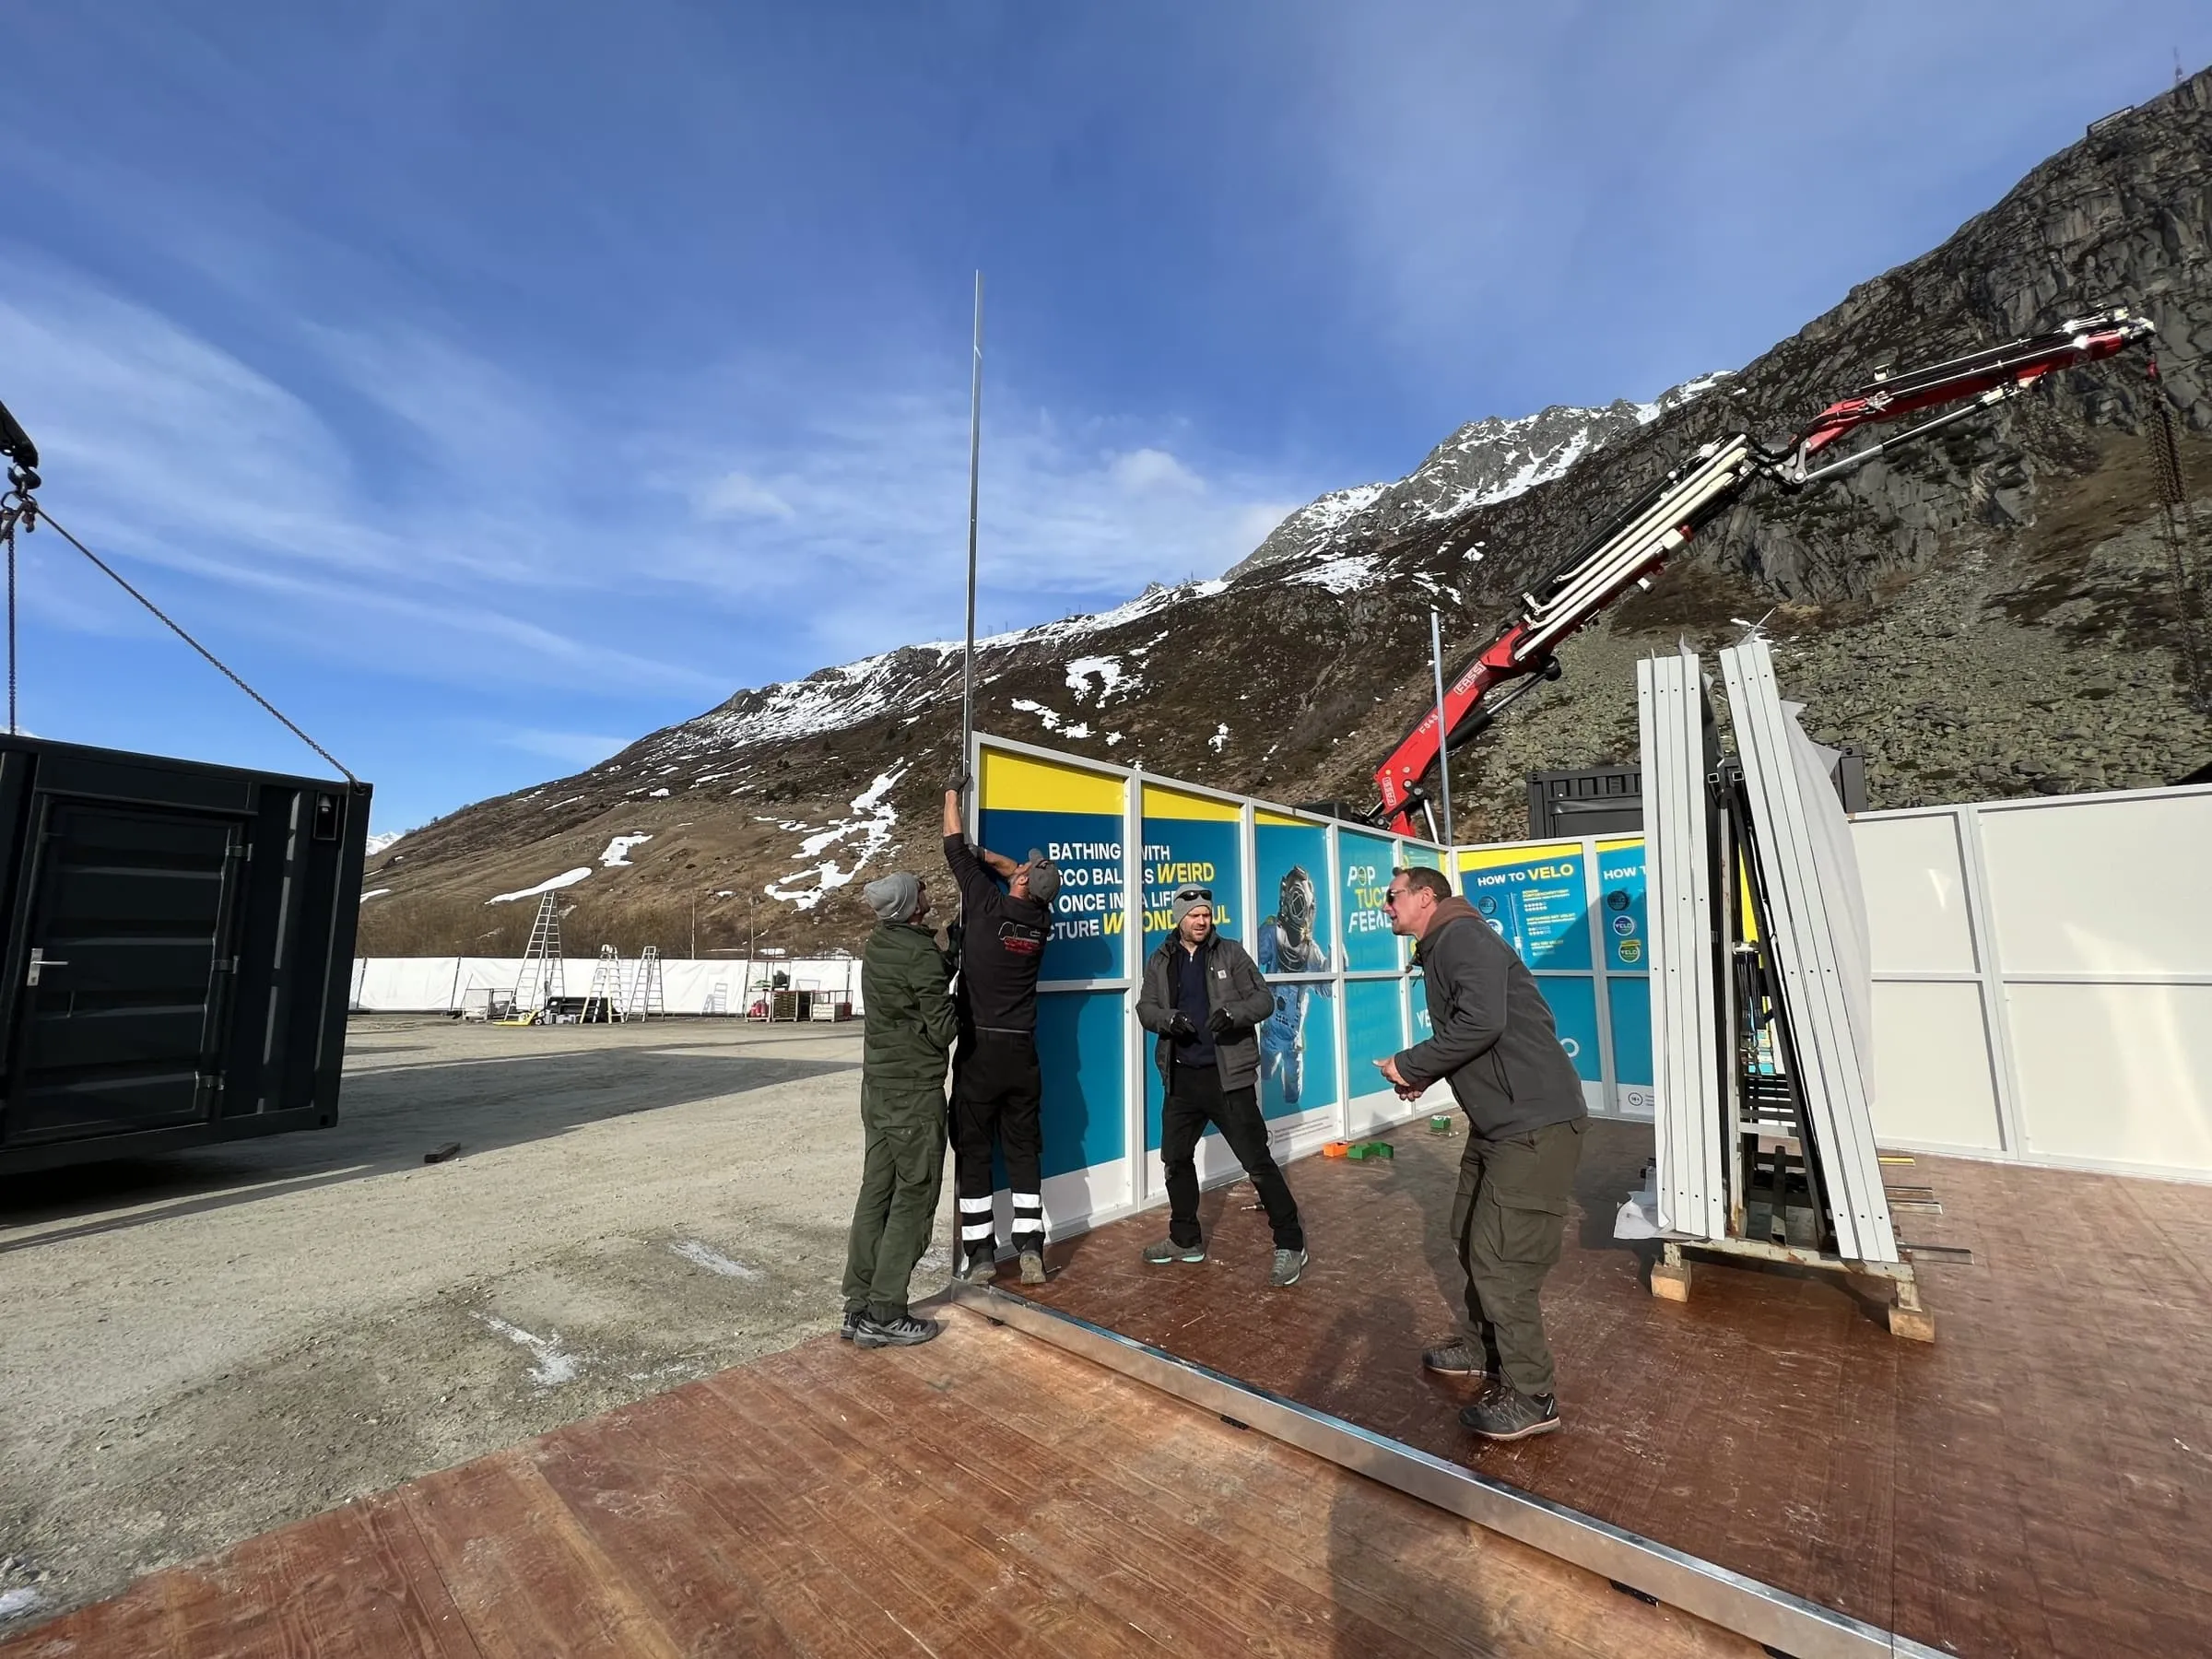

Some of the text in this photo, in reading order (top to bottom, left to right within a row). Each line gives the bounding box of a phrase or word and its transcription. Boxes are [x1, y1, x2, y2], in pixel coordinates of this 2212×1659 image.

[1048, 842, 1122, 861] BATHING
[1058, 868, 1089, 887] SCO
[1158, 863, 1215, 884] WEIRD
[1347, 865, 1376, 888] POP
[1477, 864, 1574, 887] HOW TO VELO
[1604, 866, 1636, 880] HOW
[1059, 894, 1105, 913] ONCE
[1046, 919, 1100, 942] CTURE
